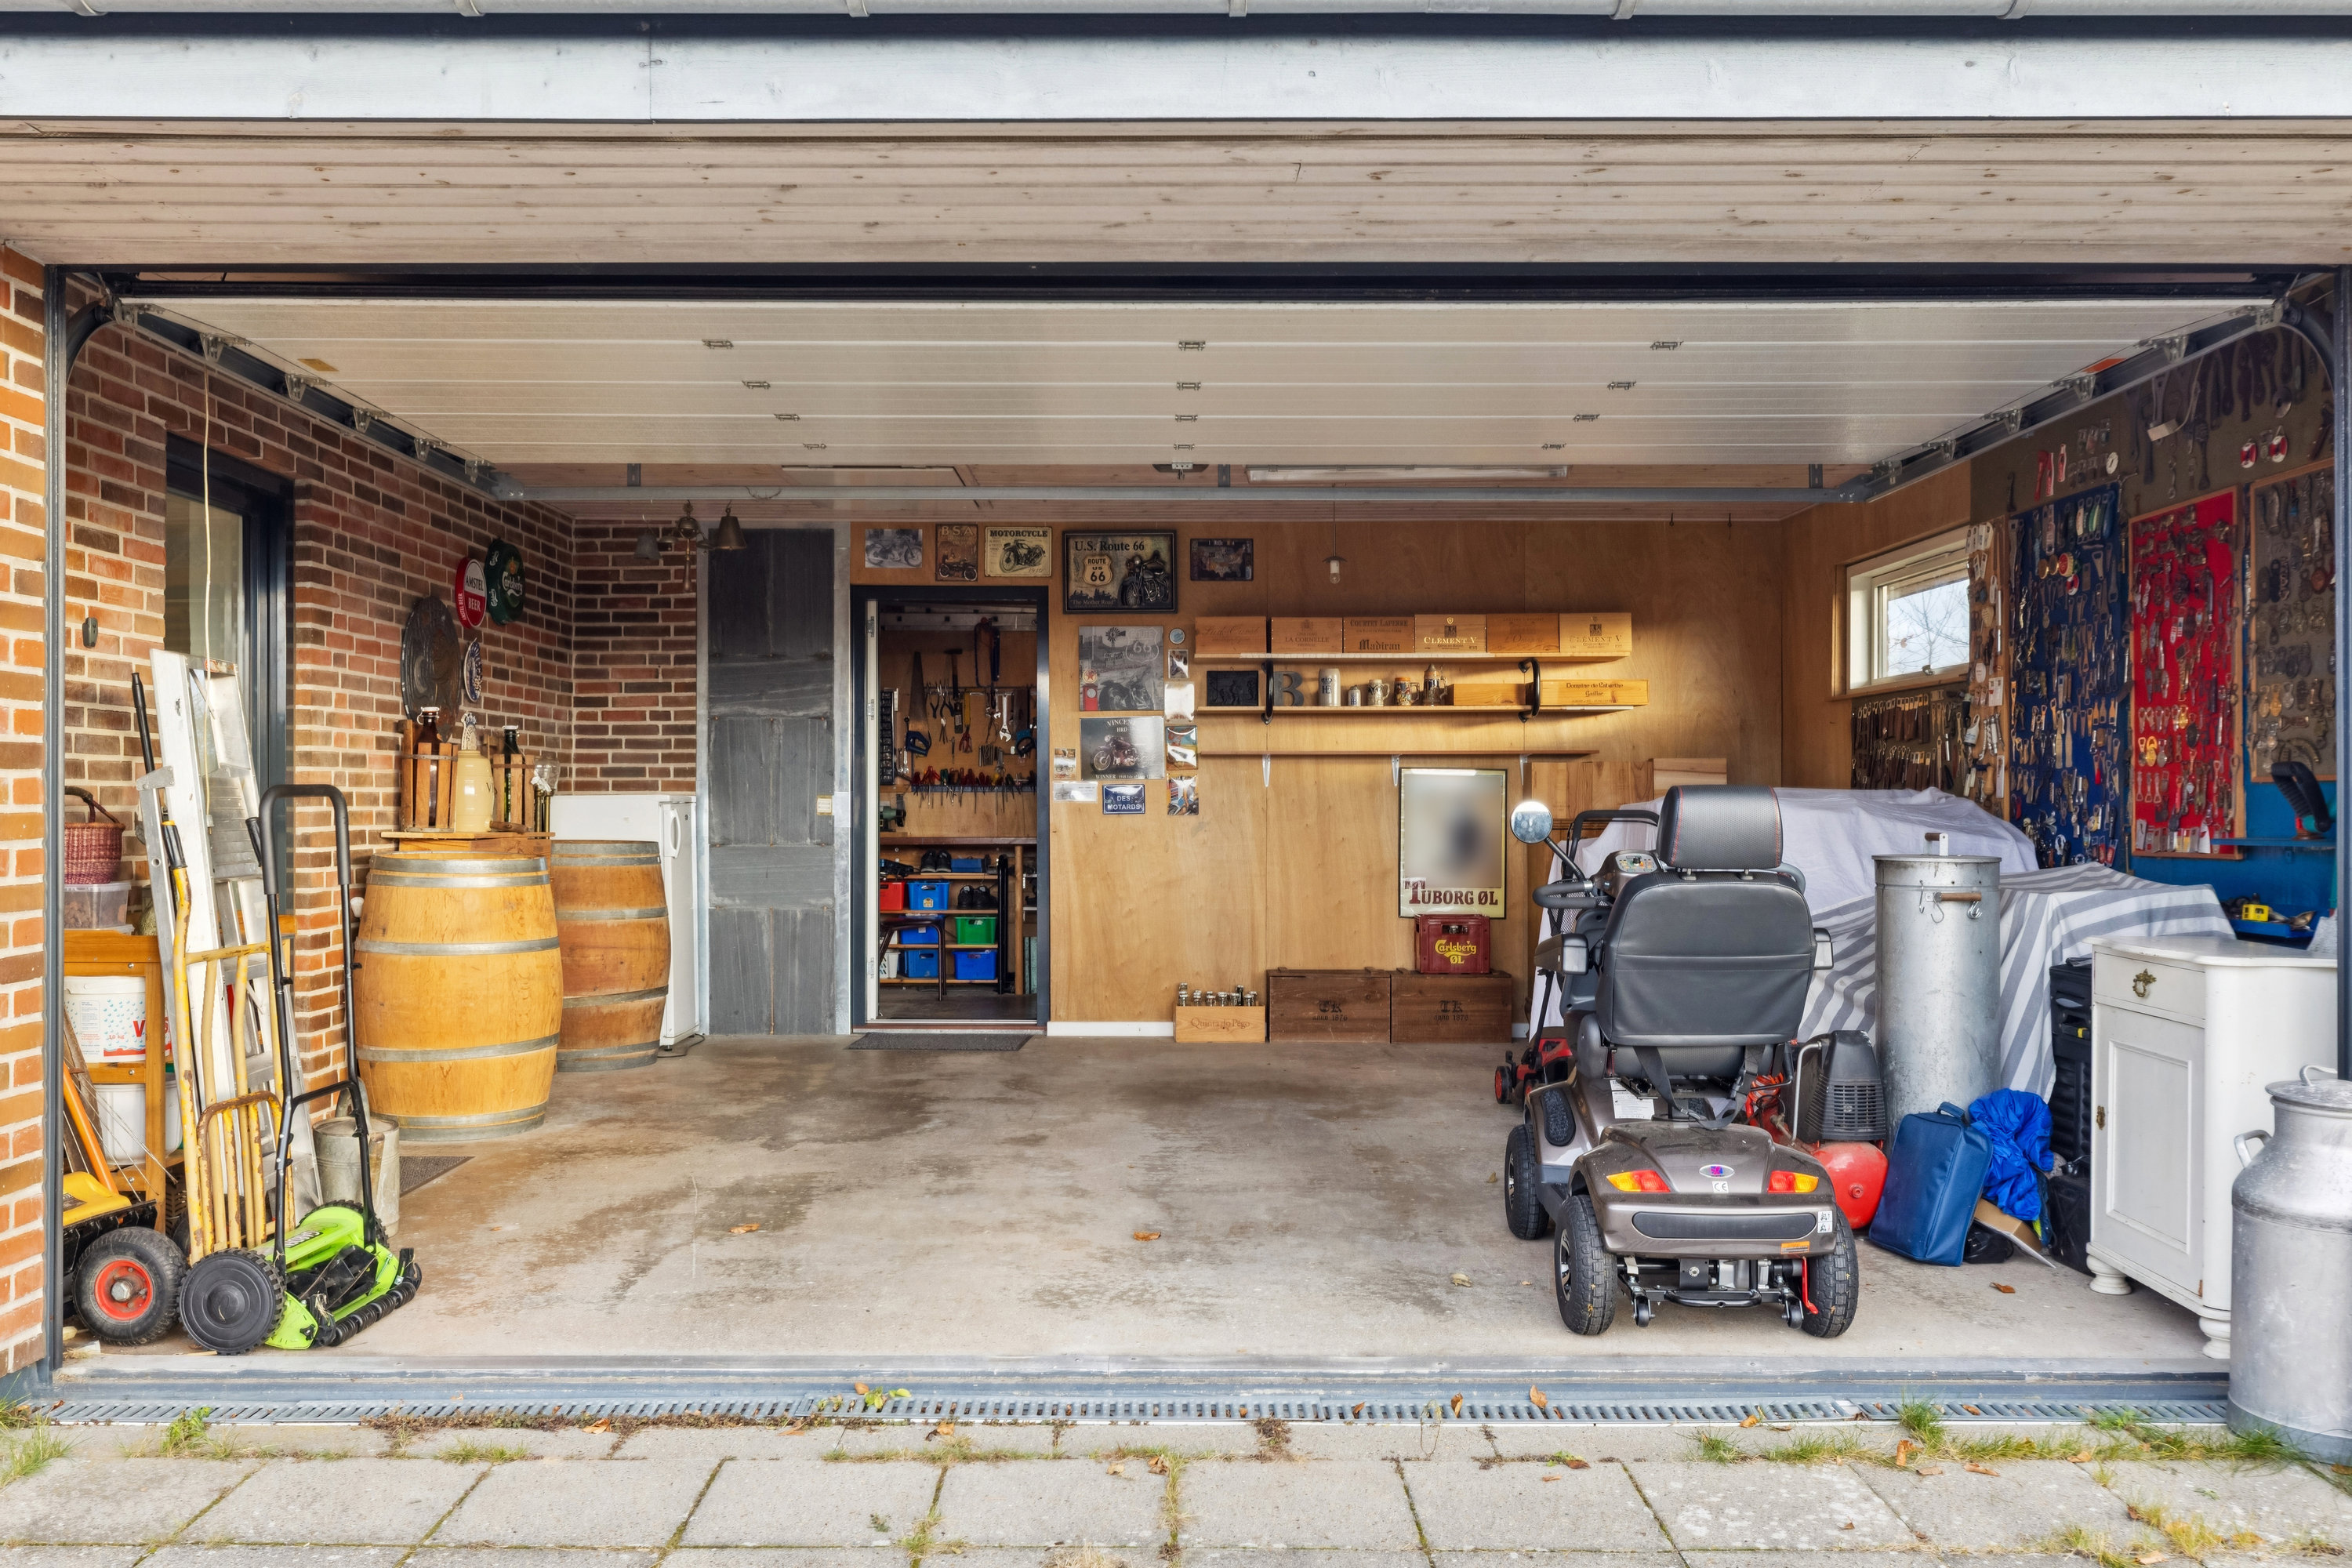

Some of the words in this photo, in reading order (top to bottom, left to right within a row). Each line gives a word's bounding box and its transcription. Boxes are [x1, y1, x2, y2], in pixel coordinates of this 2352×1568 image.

[989, 529, 1048, 538] MOTORCYCLE
[1074, 540, 1097, 551] U.S.
[1099, 540, 1130, 551] Route
[1133, 540, 1145, 551] 66
[502, 571, 523, 594] Carlsberg
[1090, 571, 1105, 582] 66
[465, 575, 484, 591] AMSTEL
[468, 597, 481, 612] BEER
[1133, 641, 1152, 653] 66
[1359, 639, 1400, 651] Madiran
[1272, 671, 1304, 706] B
[1404, 880, 1475, 905] TUBORG
[1477, 891, 1498, 905] ØL
[1435, 939, 1477, 956] Carlsberg
[1450, 955, 1465, 964] ØL
[1191, 1017, 1219, 1029] Quinta
[1714, 1182, 1728, 1192] CE
